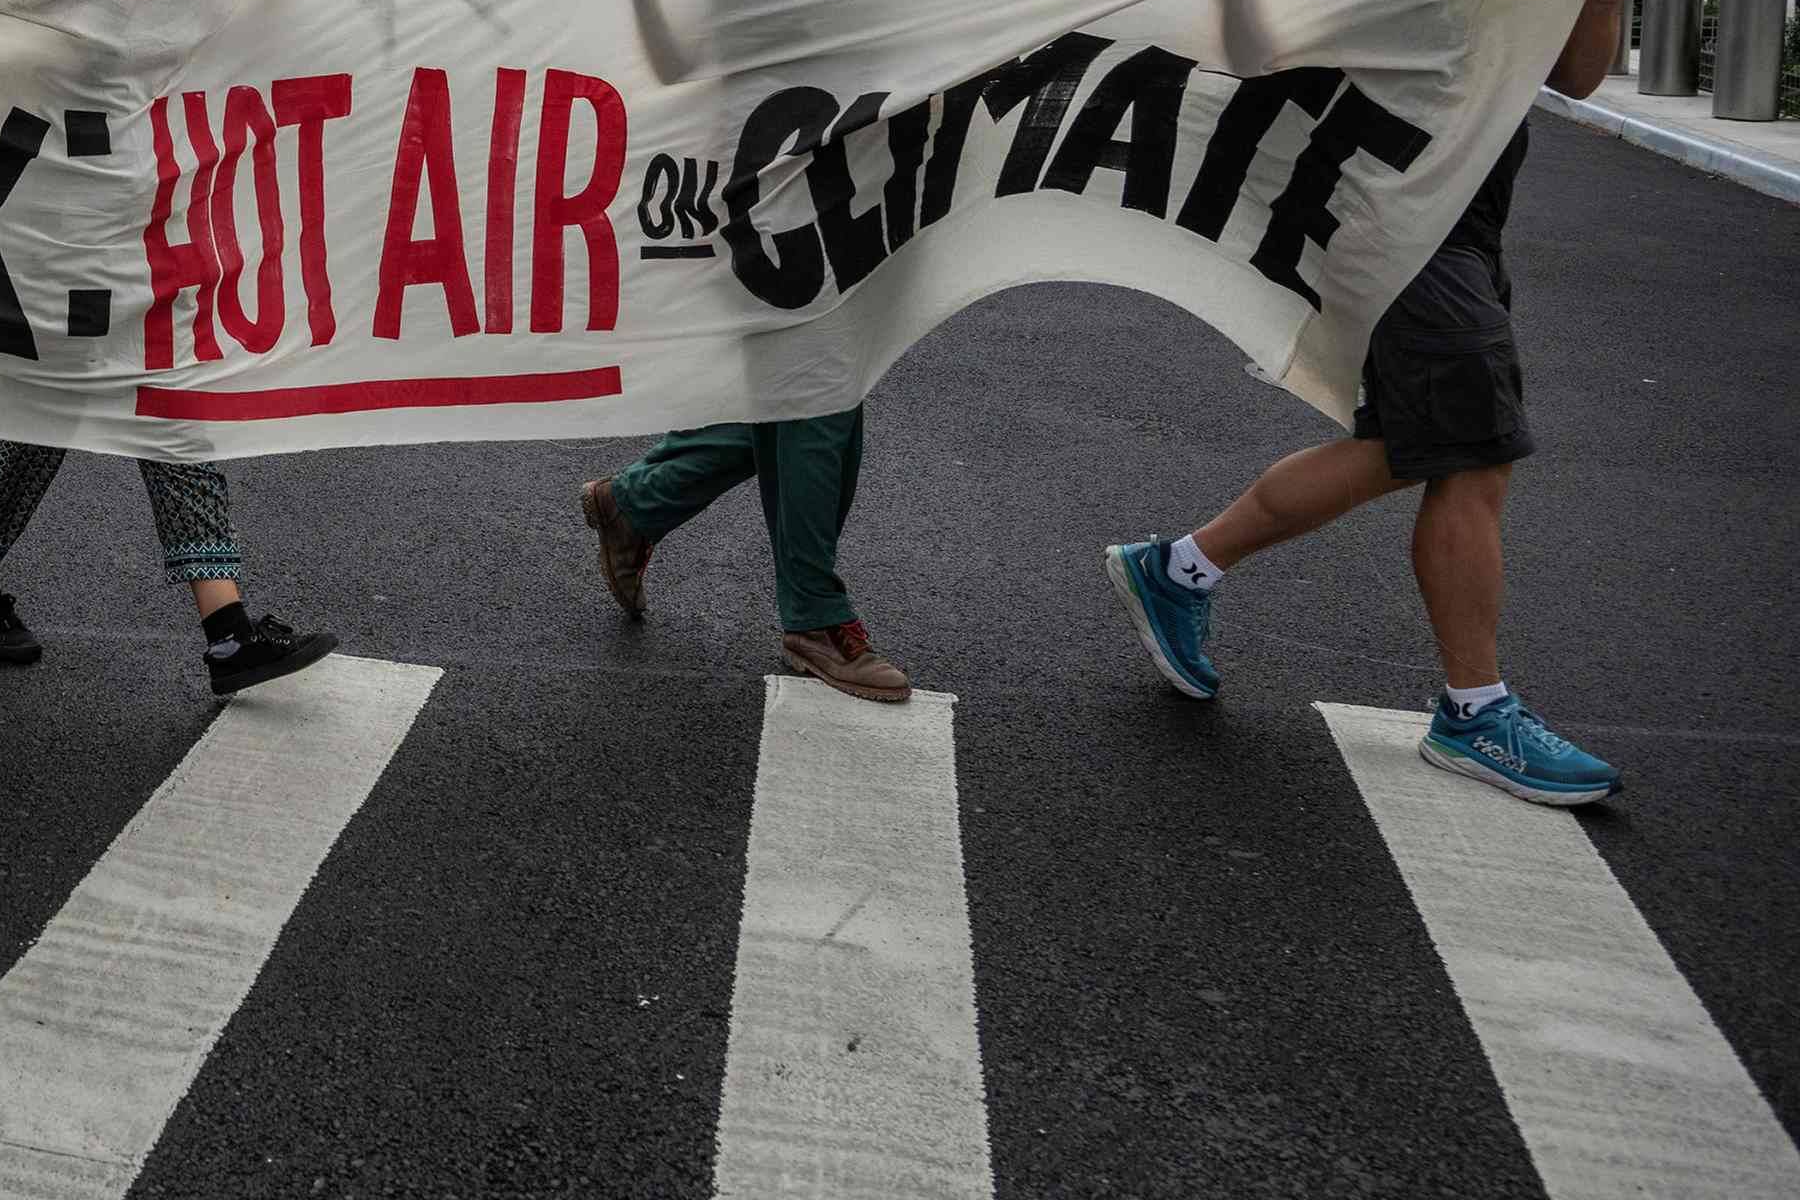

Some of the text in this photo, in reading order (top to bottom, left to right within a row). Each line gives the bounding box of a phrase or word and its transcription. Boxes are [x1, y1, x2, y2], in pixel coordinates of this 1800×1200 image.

[143, 72, 353, 371] HOT
[372, 66, 627, 341] AIR
[637, 152, 719, 241] ON
[717, 31, 1433, 314] CLIMATE
